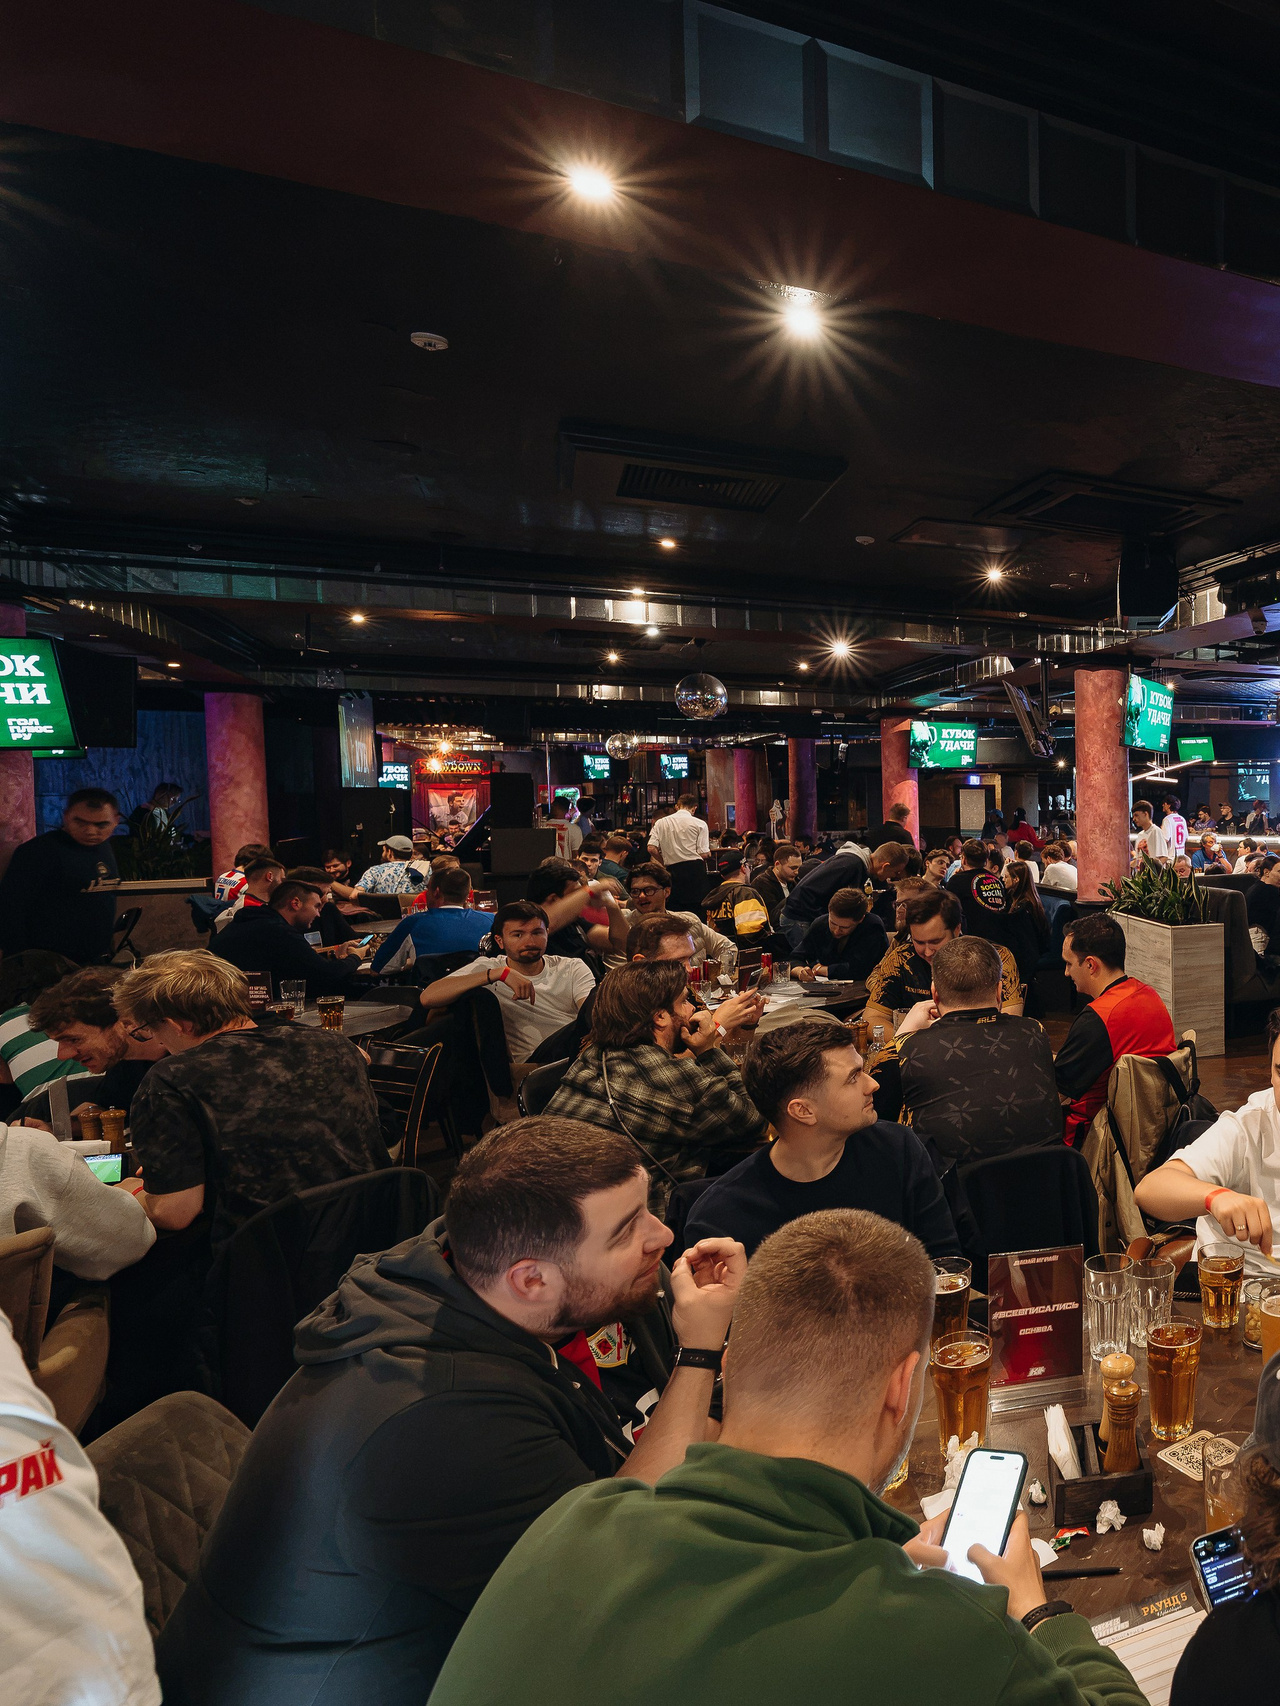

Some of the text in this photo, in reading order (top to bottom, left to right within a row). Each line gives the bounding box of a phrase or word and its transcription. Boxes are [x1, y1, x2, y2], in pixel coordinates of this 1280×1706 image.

[1149, 690, 1173, 710] КУБОК
[7, 718, 40, 726] ГОЛ
[1147, 708, 1171, 726] УДАЧИ
[9, 725, 54, 733] ПЛЮС
[941, 729, 976, 739] КУБОК
[939, 741, 975, 752] УДАЧИ
[420, 760, 482, 772] SWDOWN
[1175, 823, 1184, 845] 6
[980, 883, 1001, 891] SOCIAL
[982, 889, 1003, 897] SOCIAL
[1141, 1594, 1181, 1616] РАУНД
[1180, 1592, 1188, 1602] 5
